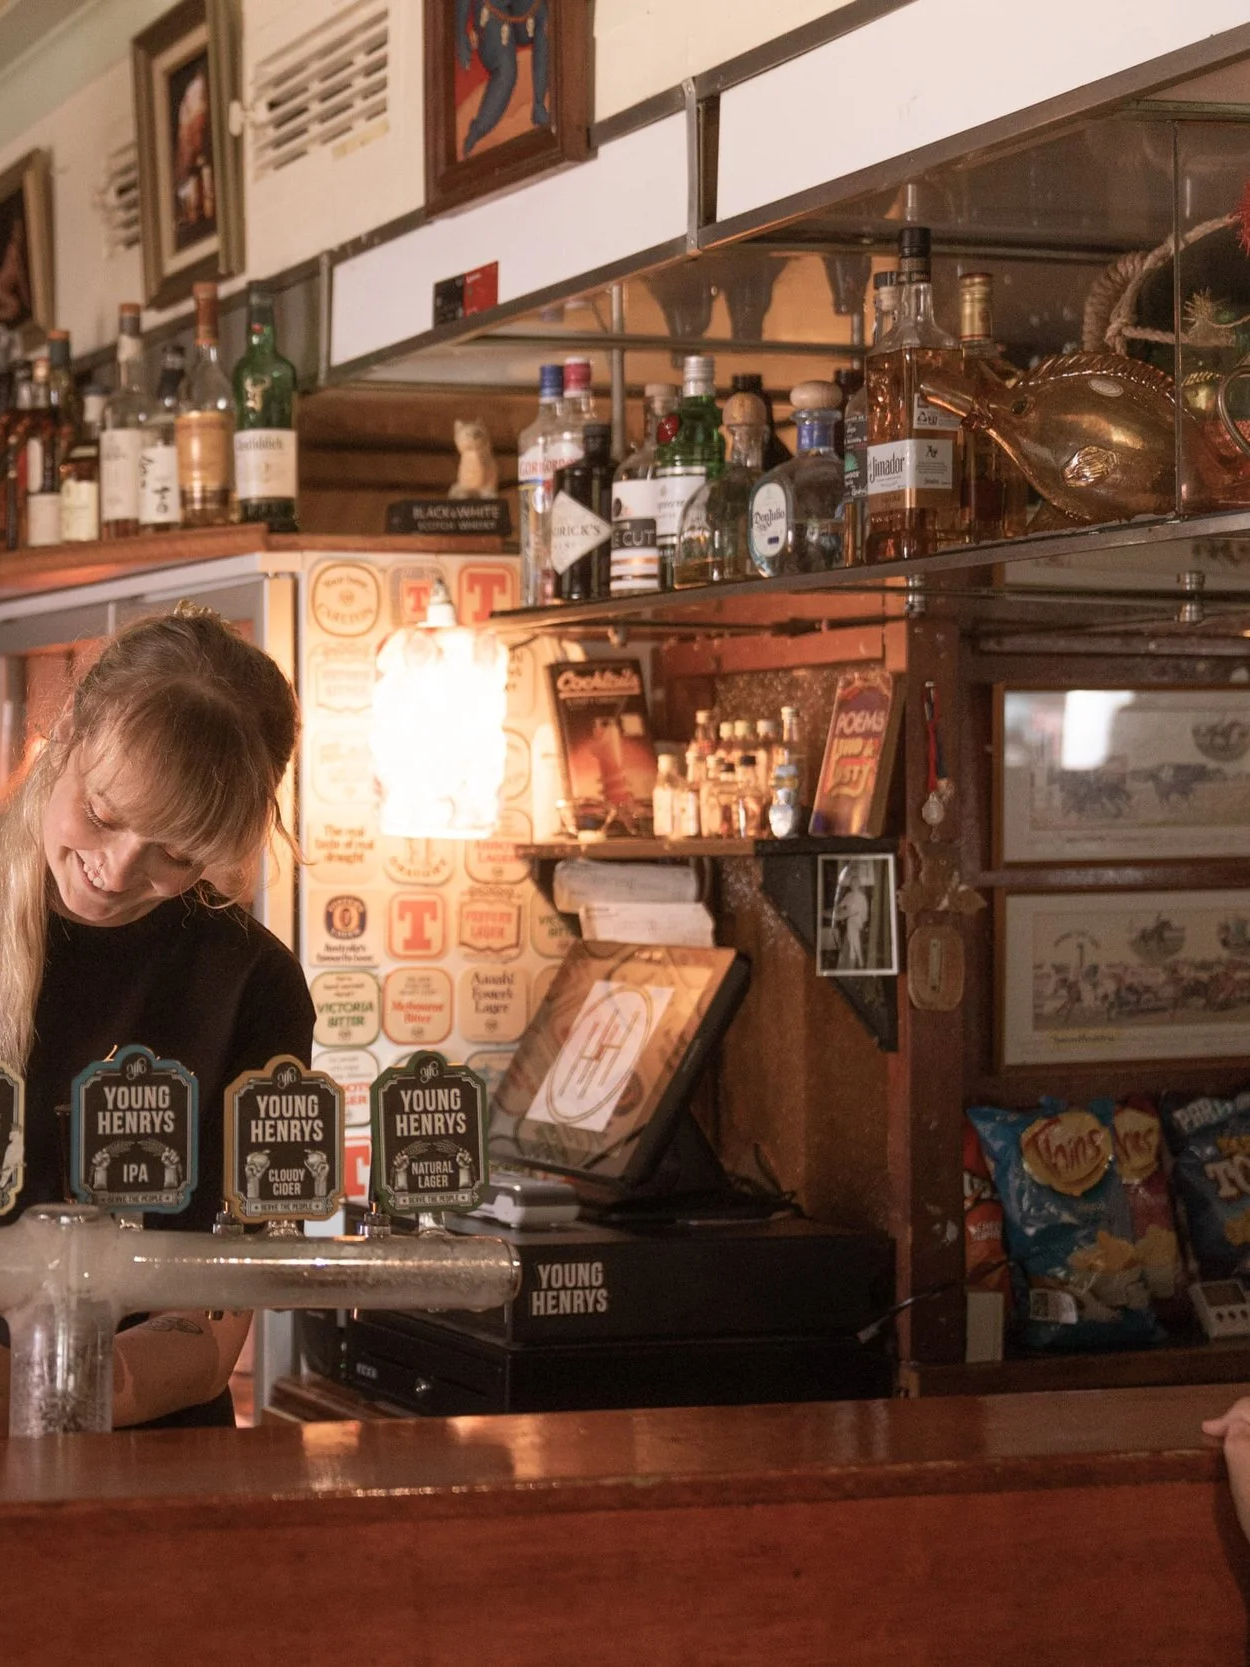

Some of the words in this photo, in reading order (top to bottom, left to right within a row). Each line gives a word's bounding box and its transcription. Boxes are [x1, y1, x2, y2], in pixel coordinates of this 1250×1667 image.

[466, 572, 507, 622] T
[397, 900, 438, 950] T
[316, 1001, 374, 1014] VICTORIA
[103, 1086, 170, 1110] YOUNG
[256, 1095, 319, 1119] YOUNG
[400, 1088, 461, 1113] YOUNG
[97, 1111, 175, 1135] HENRYS
[250, 1119, 324, 1143] HENRYS
[395, 1112, 467, 1137] HENRYS
[122, 1163, 149, 1183] IPA
[268, 1168, 306, 1182] CLOUDY
[411, 1160, 454, 1175] NATURAL
[273, 1182, 302, 1196] CIDER
[418, 1174, 449, 1189] LAGER
[537, 1261, 604, 1289] YOUNG
[531, 1288, 609, 1316] HENRYS
